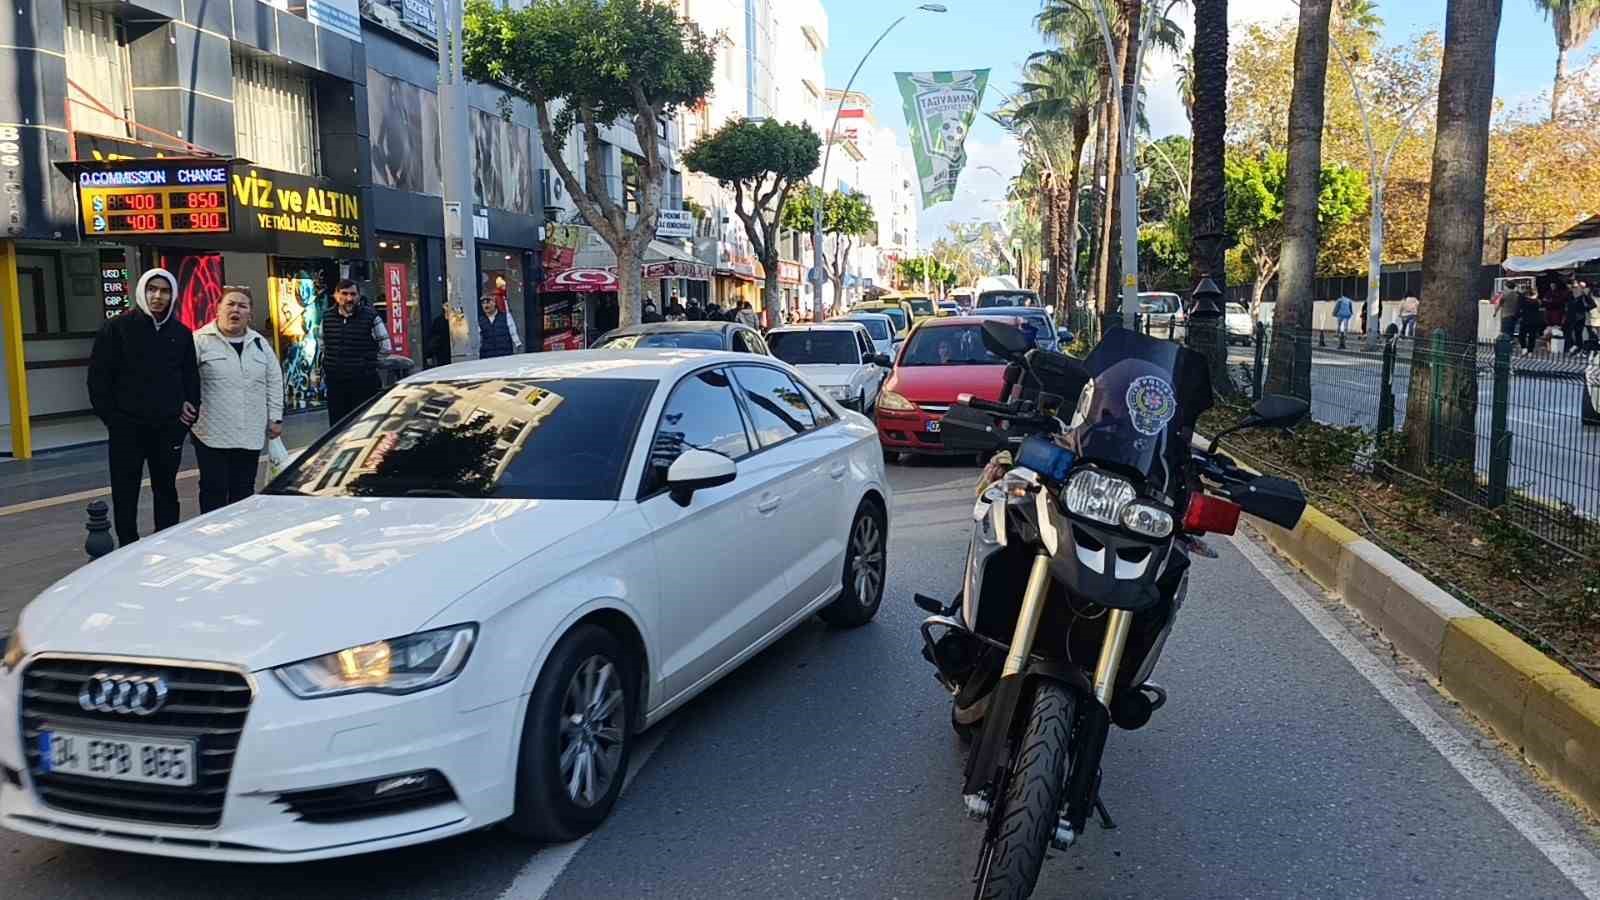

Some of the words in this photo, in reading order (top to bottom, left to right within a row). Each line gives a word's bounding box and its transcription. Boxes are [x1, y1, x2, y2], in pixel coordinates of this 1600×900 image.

[177, 168, 226, 183] CHANGE
[126, 194, 154, 209] 400
[188, 192, 218, 208] 850
[233, 170, 274, 209] VİZ
[277, 188, 303, 213] ve
[305, 187, 358, 220] ALTIN
[127, 214, 156, 230] 400
[189, 212, 219, 228] 900
[102, 269, 120, 278] USD
[103, 282, 122, 292] EUR
[105, 296, 122, 305] GBP
